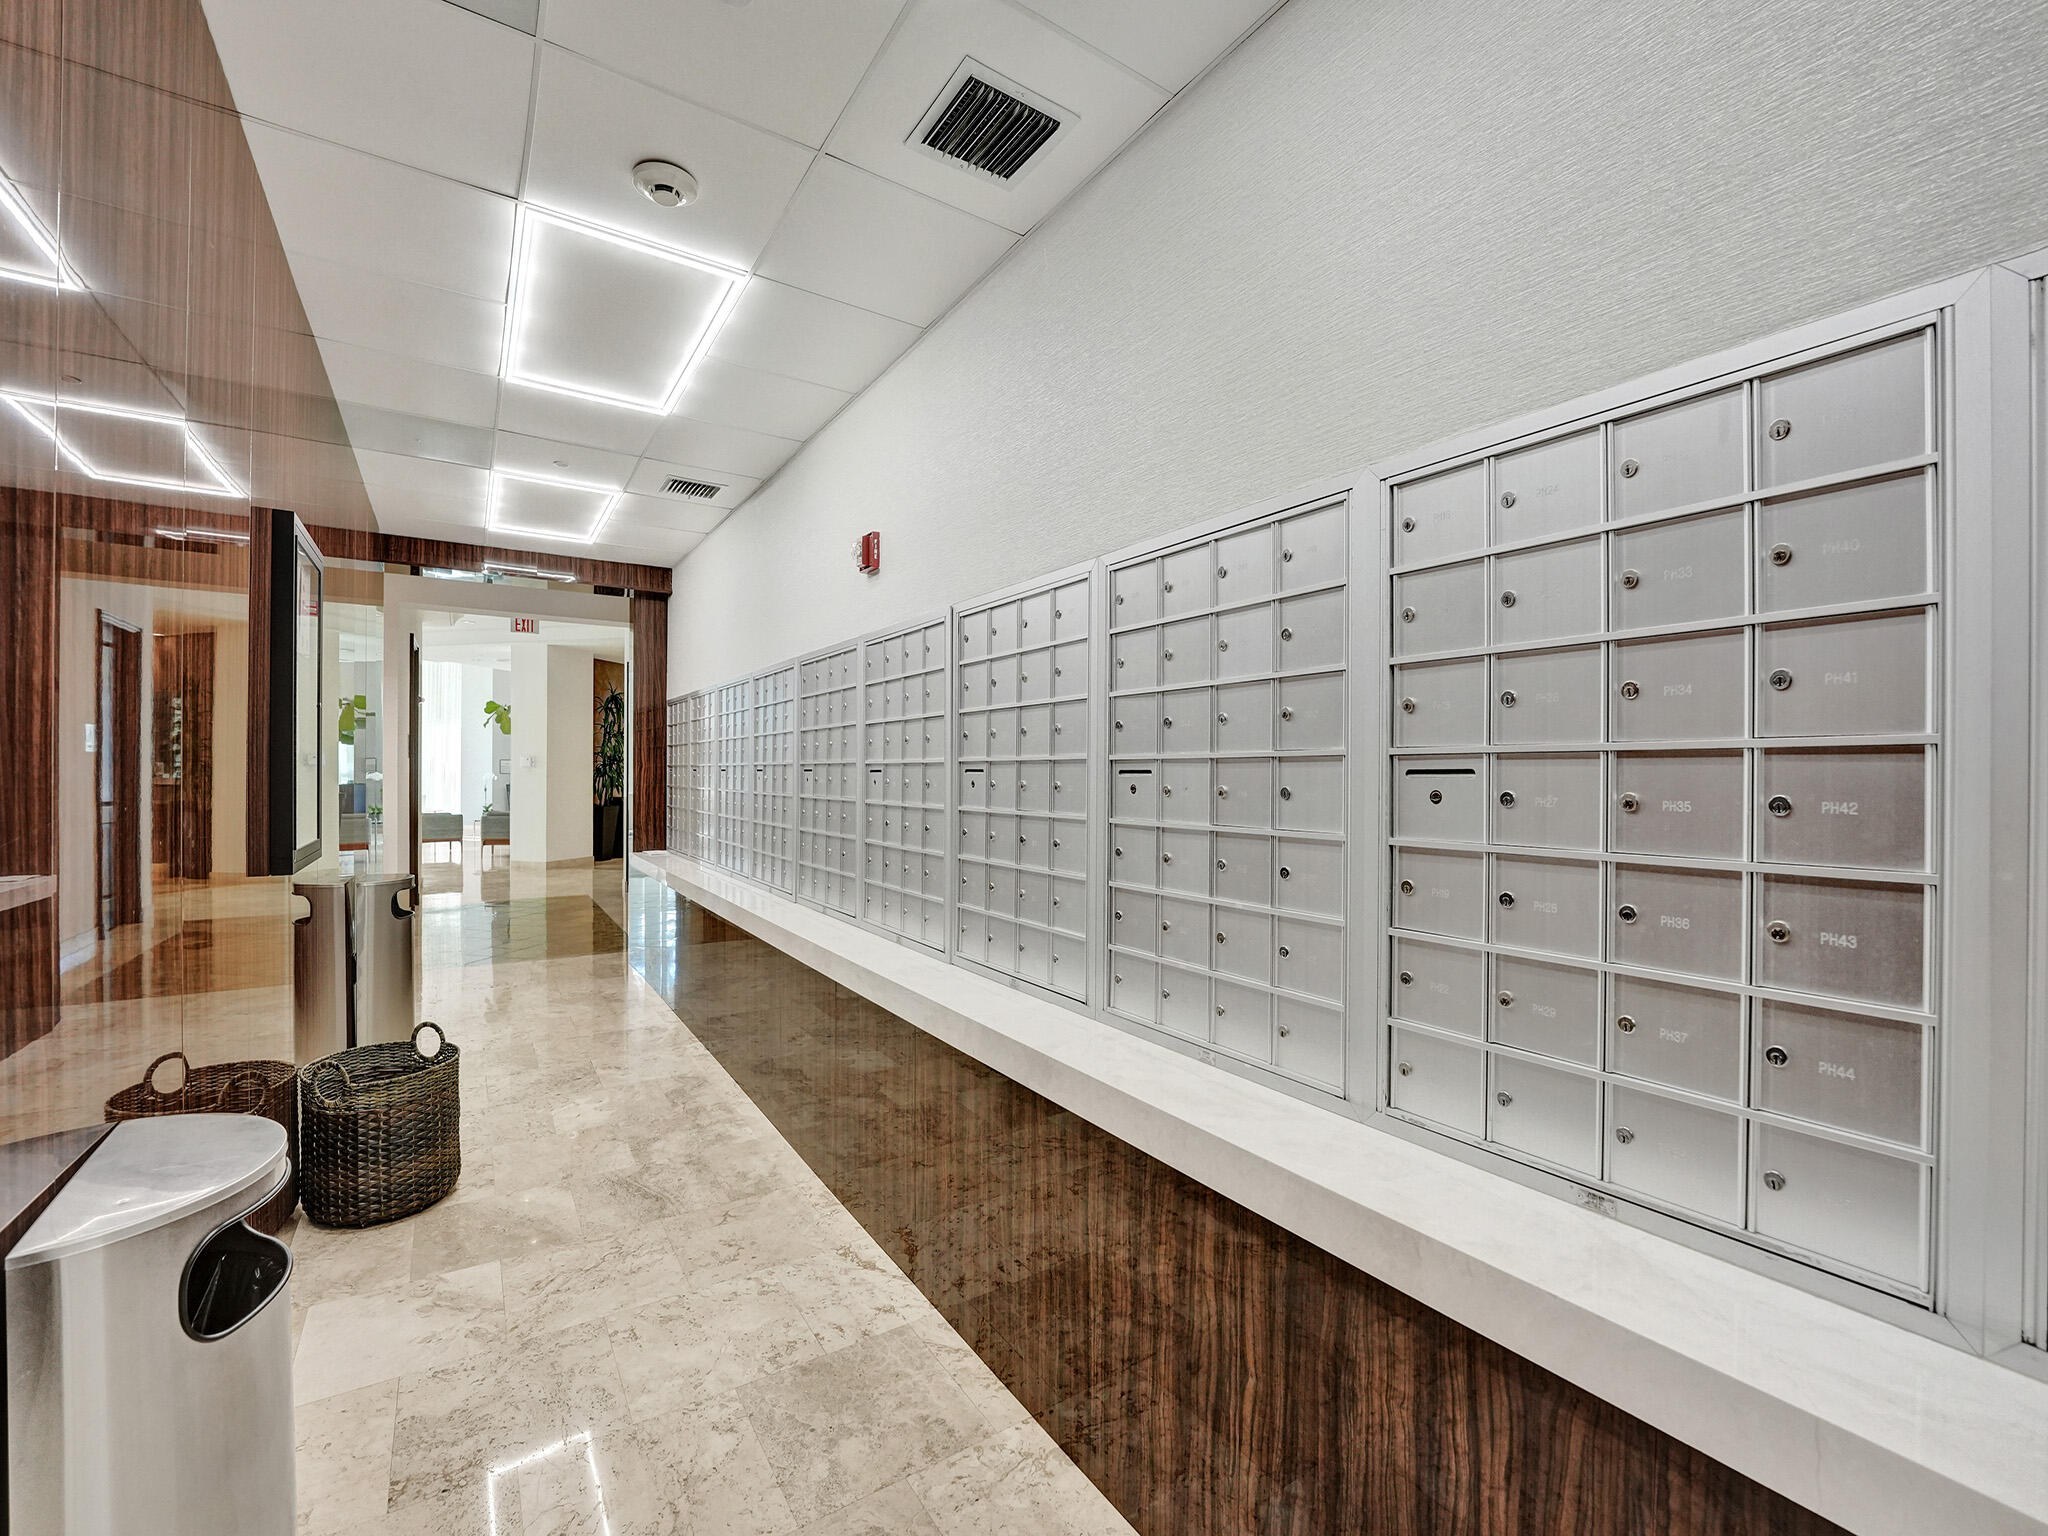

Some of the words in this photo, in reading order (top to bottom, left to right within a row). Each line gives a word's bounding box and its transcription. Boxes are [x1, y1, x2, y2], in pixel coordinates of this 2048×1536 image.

[516, 617, 533, 632] EXIT
[1824, 672, 1858, 685] PH41
[1663, 685, 1693, 697] PH34
[1662, 800, 1692, 813] PH35
[1821, 801, 1859, 816] PH42
[1660, 915, 1690, 929] PH36
[1820, 932, 1858, 949] PH43
[1532, 1003, 1557, 1018] PH29
[1659, 1027, 1689, 1043] PH37
[1818, 1061, 1856, 1080] PH44
